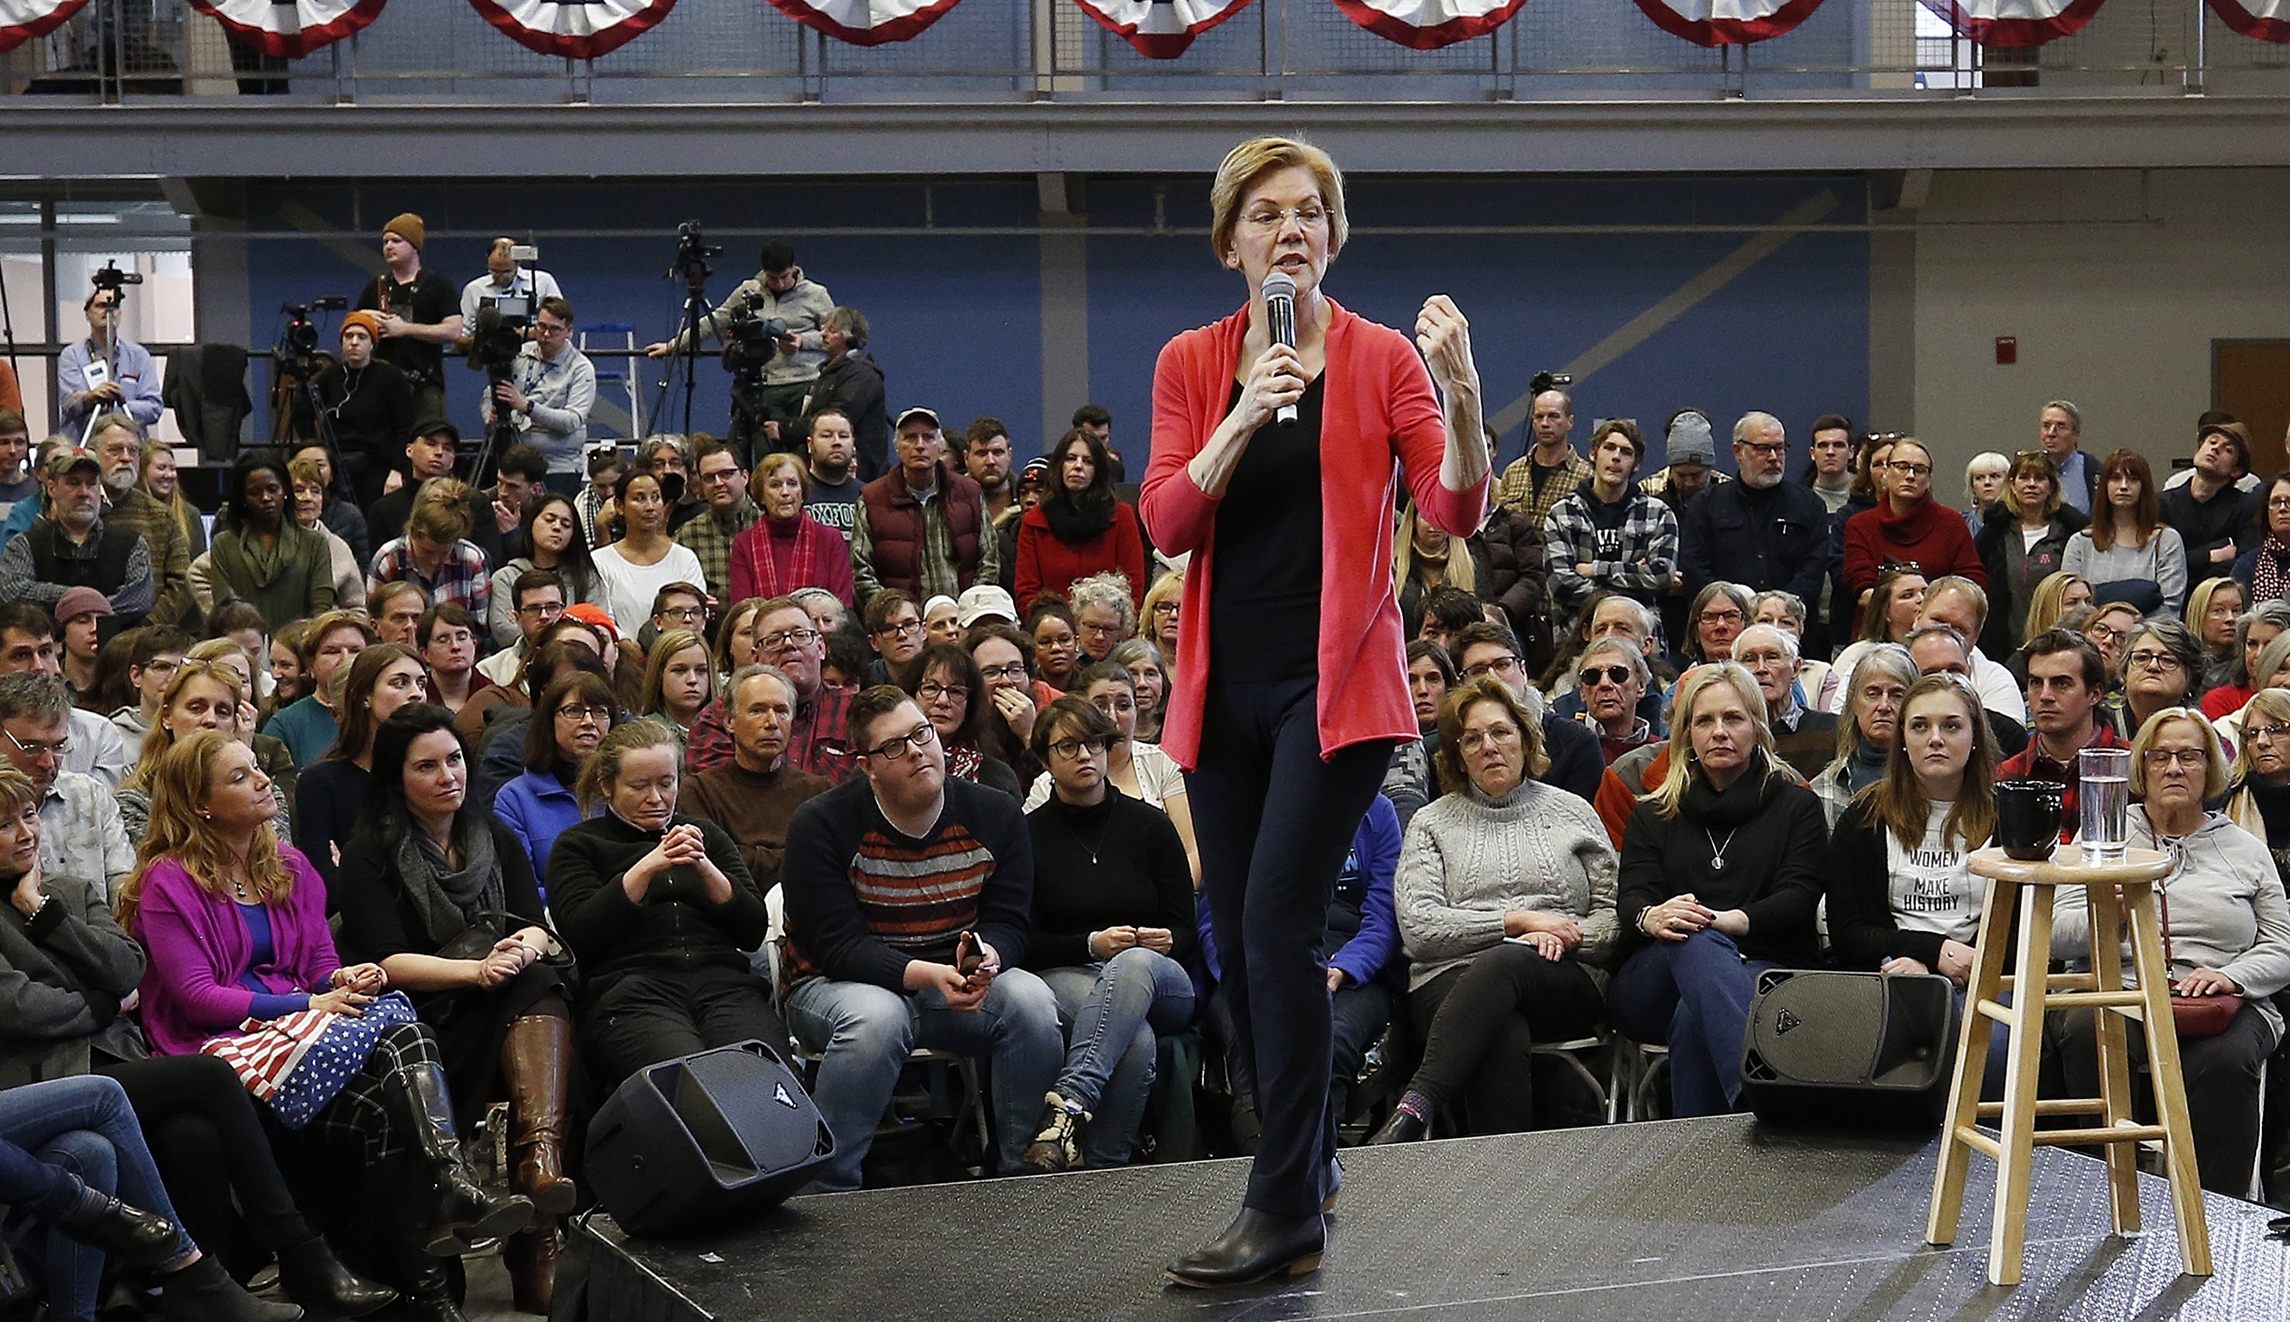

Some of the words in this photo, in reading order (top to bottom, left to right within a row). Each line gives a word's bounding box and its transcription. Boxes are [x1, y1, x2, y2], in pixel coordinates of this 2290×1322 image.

[803, 503, 856, 527] XFO
[1909, 849, 1959, 868] WOMEN
[1914, 877, 1950, 895] MAKE
[1904, 894, 1959, 911] HISTORY
